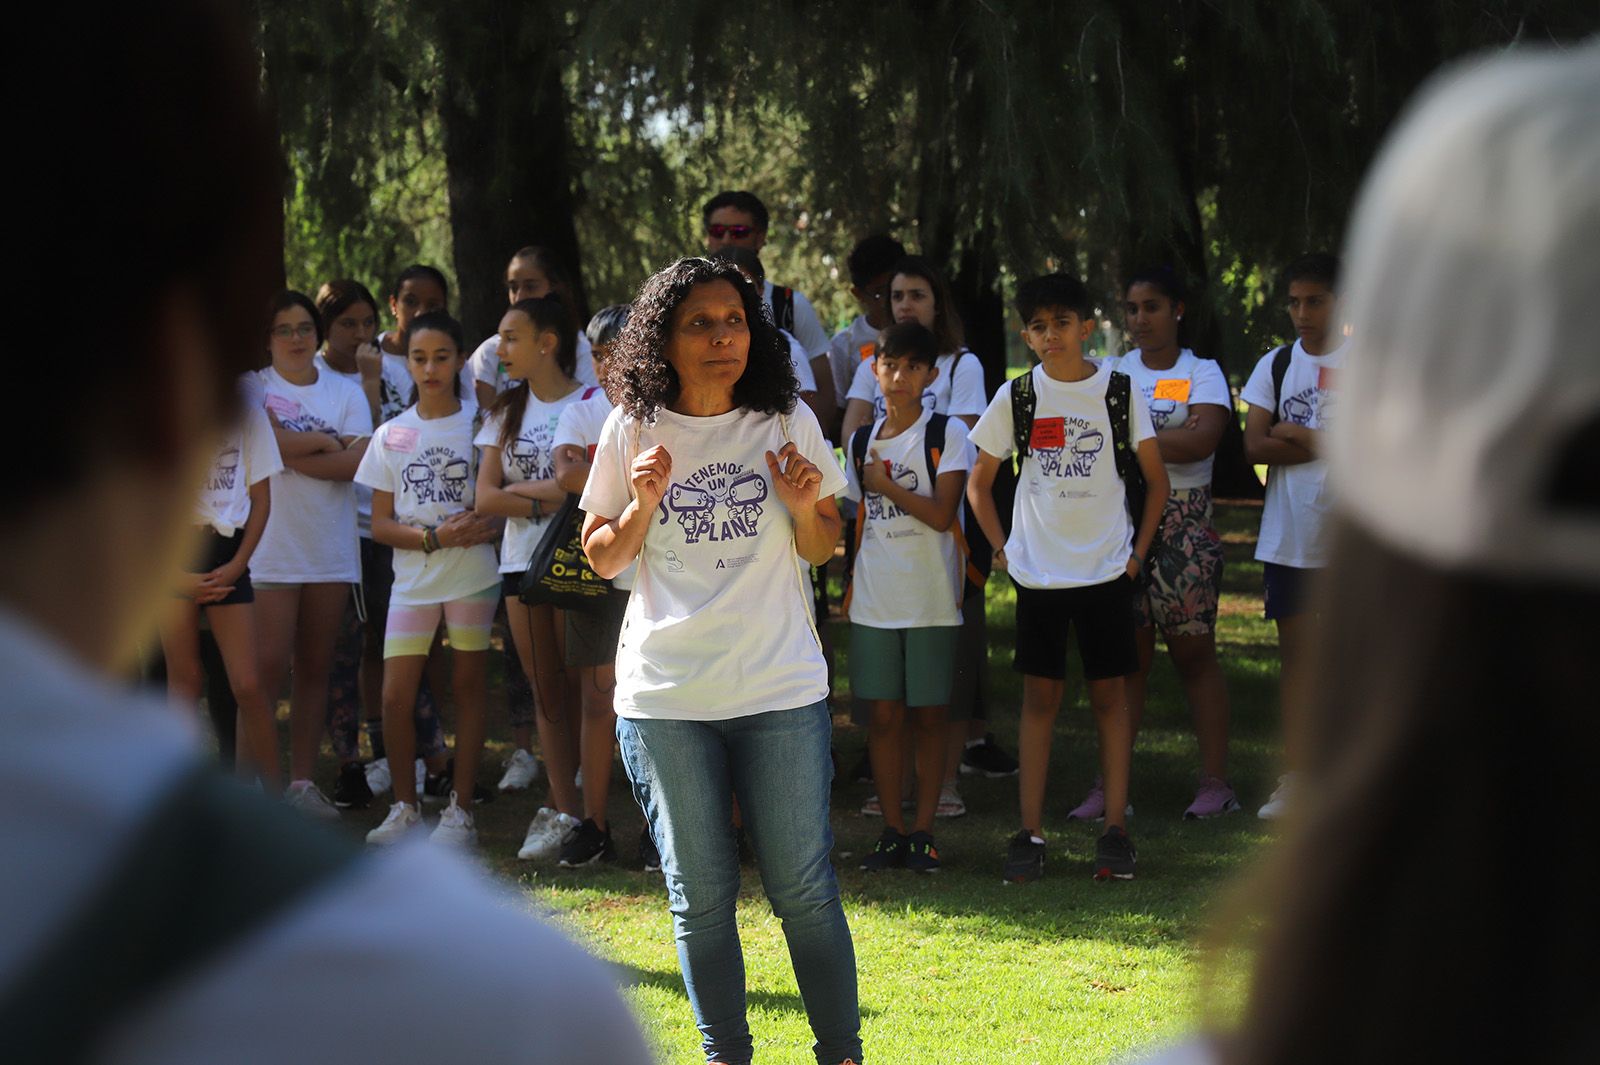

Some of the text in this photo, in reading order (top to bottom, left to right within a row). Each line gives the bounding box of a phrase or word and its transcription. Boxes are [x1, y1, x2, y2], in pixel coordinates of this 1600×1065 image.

[430, 457, 442, 466] UN
[1047, 460, 1084, 478] PLAN
[685, 462, 744, 488] TENEMOS
[707, 477, 726, 491] UN
[695, 516, 748, 542] PLAN
